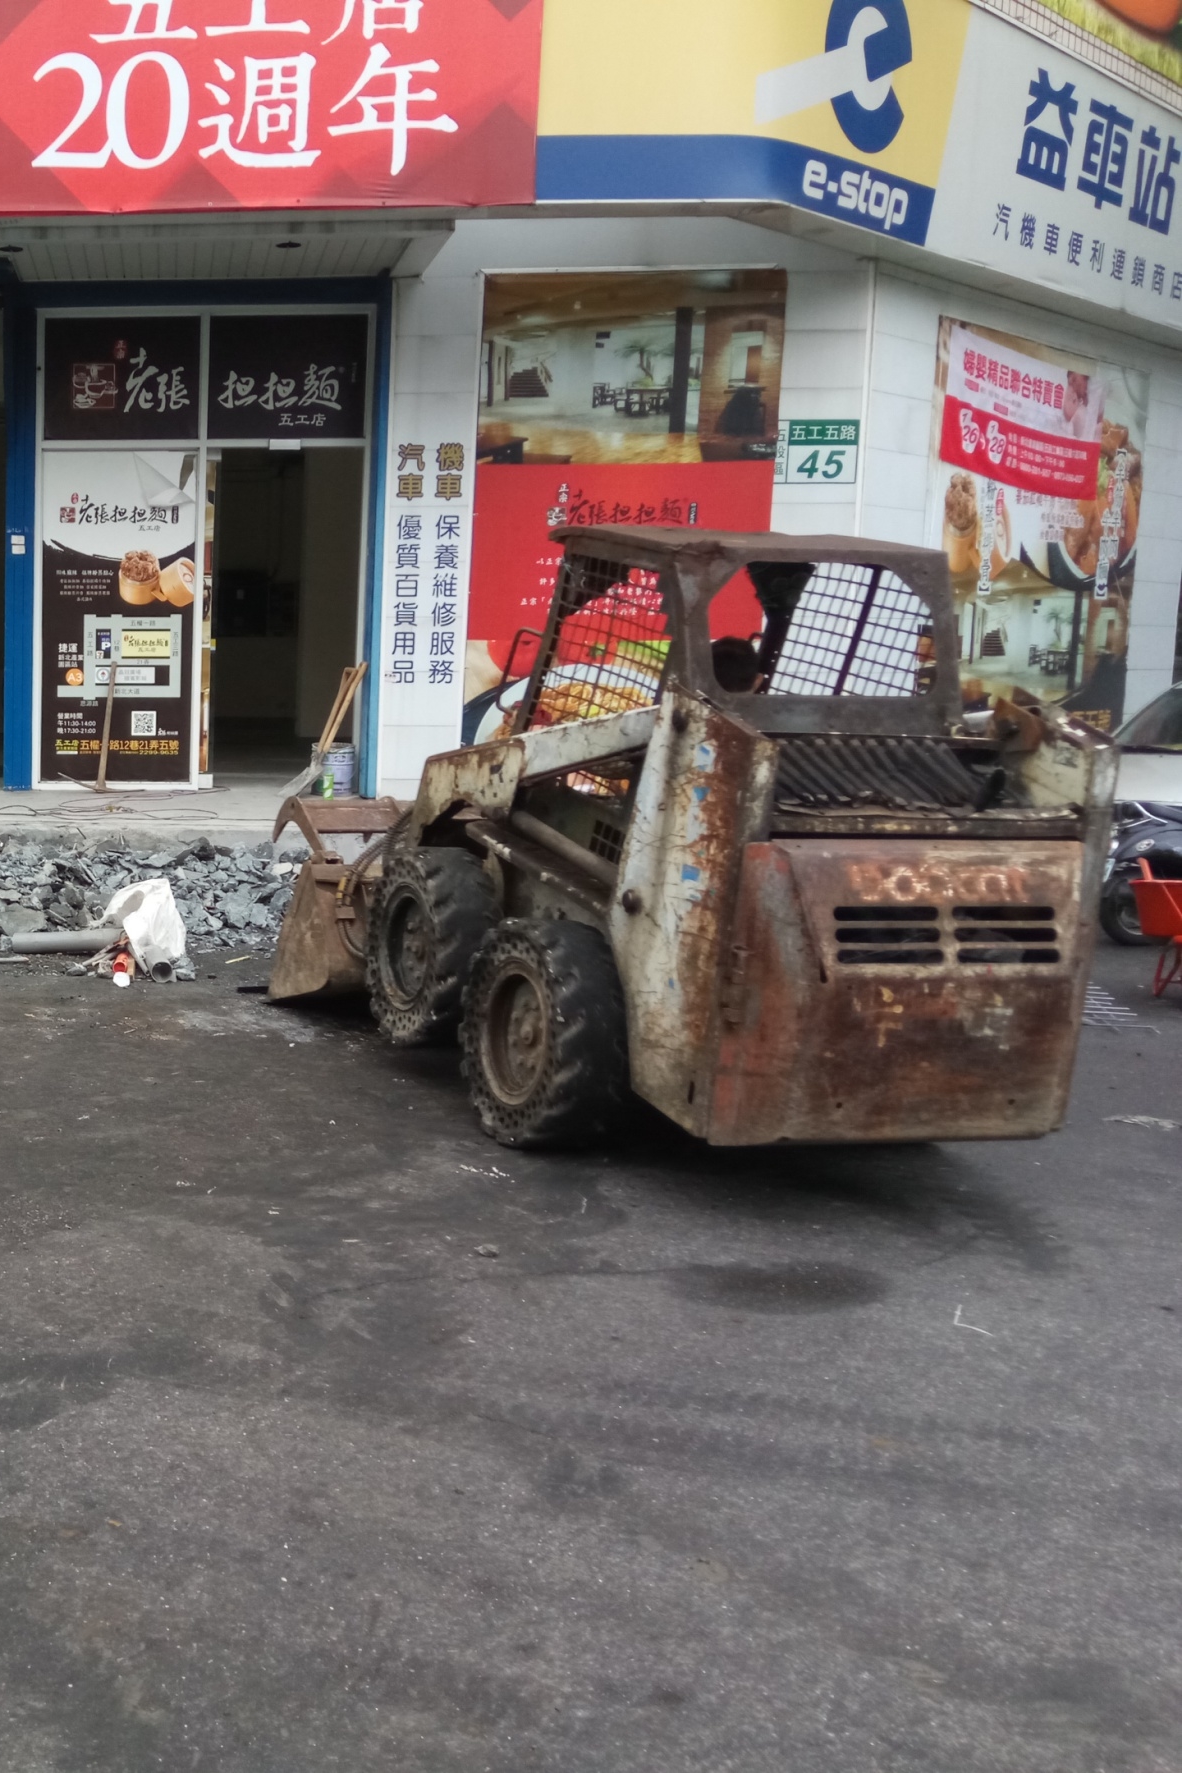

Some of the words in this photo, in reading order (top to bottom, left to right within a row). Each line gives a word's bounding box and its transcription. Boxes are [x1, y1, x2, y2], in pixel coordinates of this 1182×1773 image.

[31, 42, 459, 176] 20週年
[1016, 67, 1180, 236] 益車站
[803, 160, 908, 230] e-stop
[993, 203, 1182, 301] 汽機車便利連鎖商店
[278, 413, 326, 427] 五工店
[791, 425, 856, 441] 五工五路
[963, 425, 978, 444] 26
[990, 436, 1005, 454] 28
[396, 443, 425, 501] 汽車
[436, 443, 464, 501] 機車
[797, 450, 846, 479] 45
[391, 514, 422, 684] 優質百貨用品
[428, 514, 460, 684] 保養維修服務
[67, 672, 83, 682] A3
